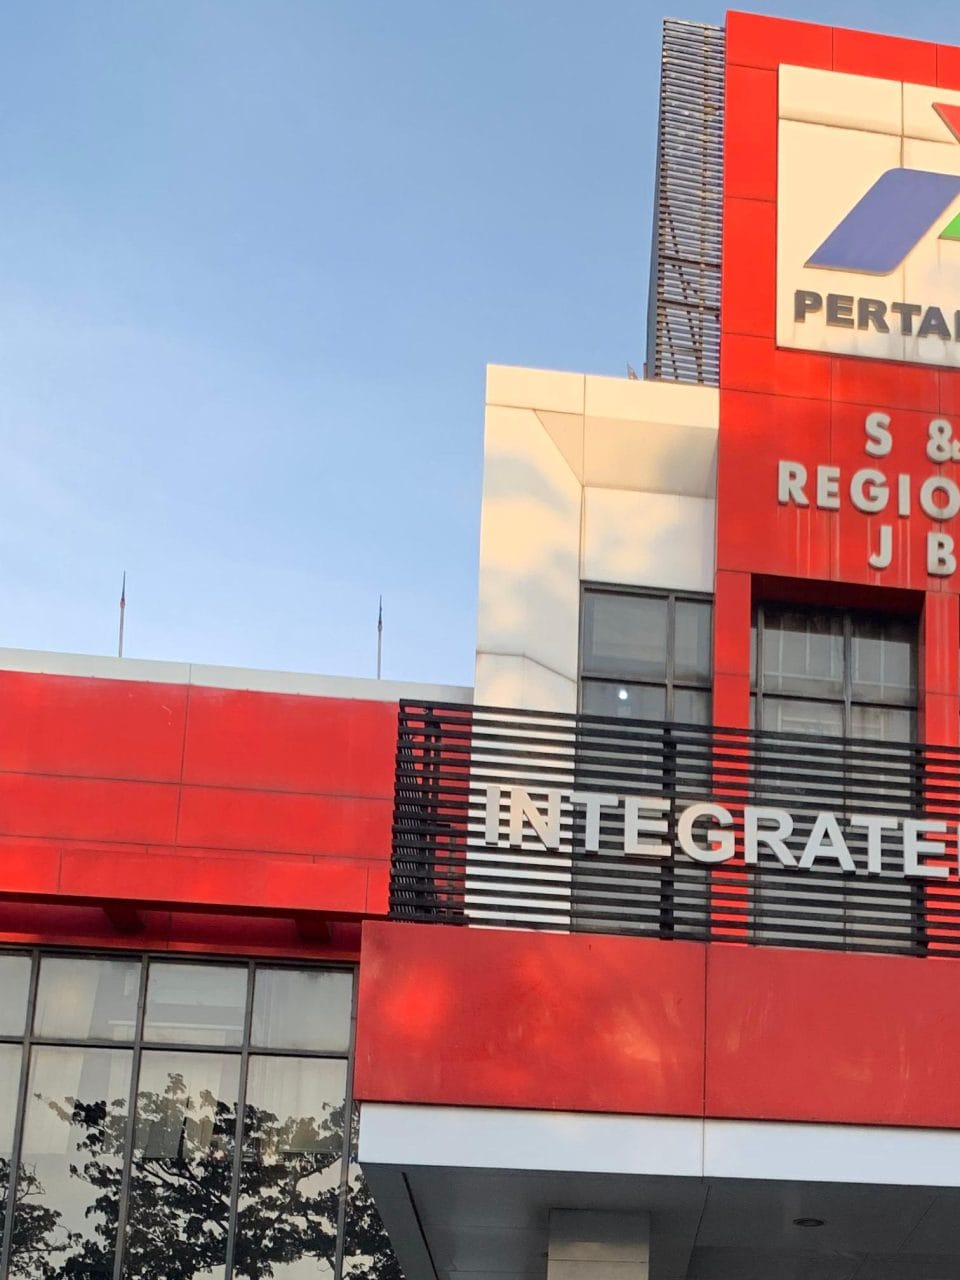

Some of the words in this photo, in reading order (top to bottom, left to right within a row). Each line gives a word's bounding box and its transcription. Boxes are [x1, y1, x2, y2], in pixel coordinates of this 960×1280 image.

[865, 412, 892, 458] S
[869, 525, 892, 569] J
[927, 532, 957, 577] B
